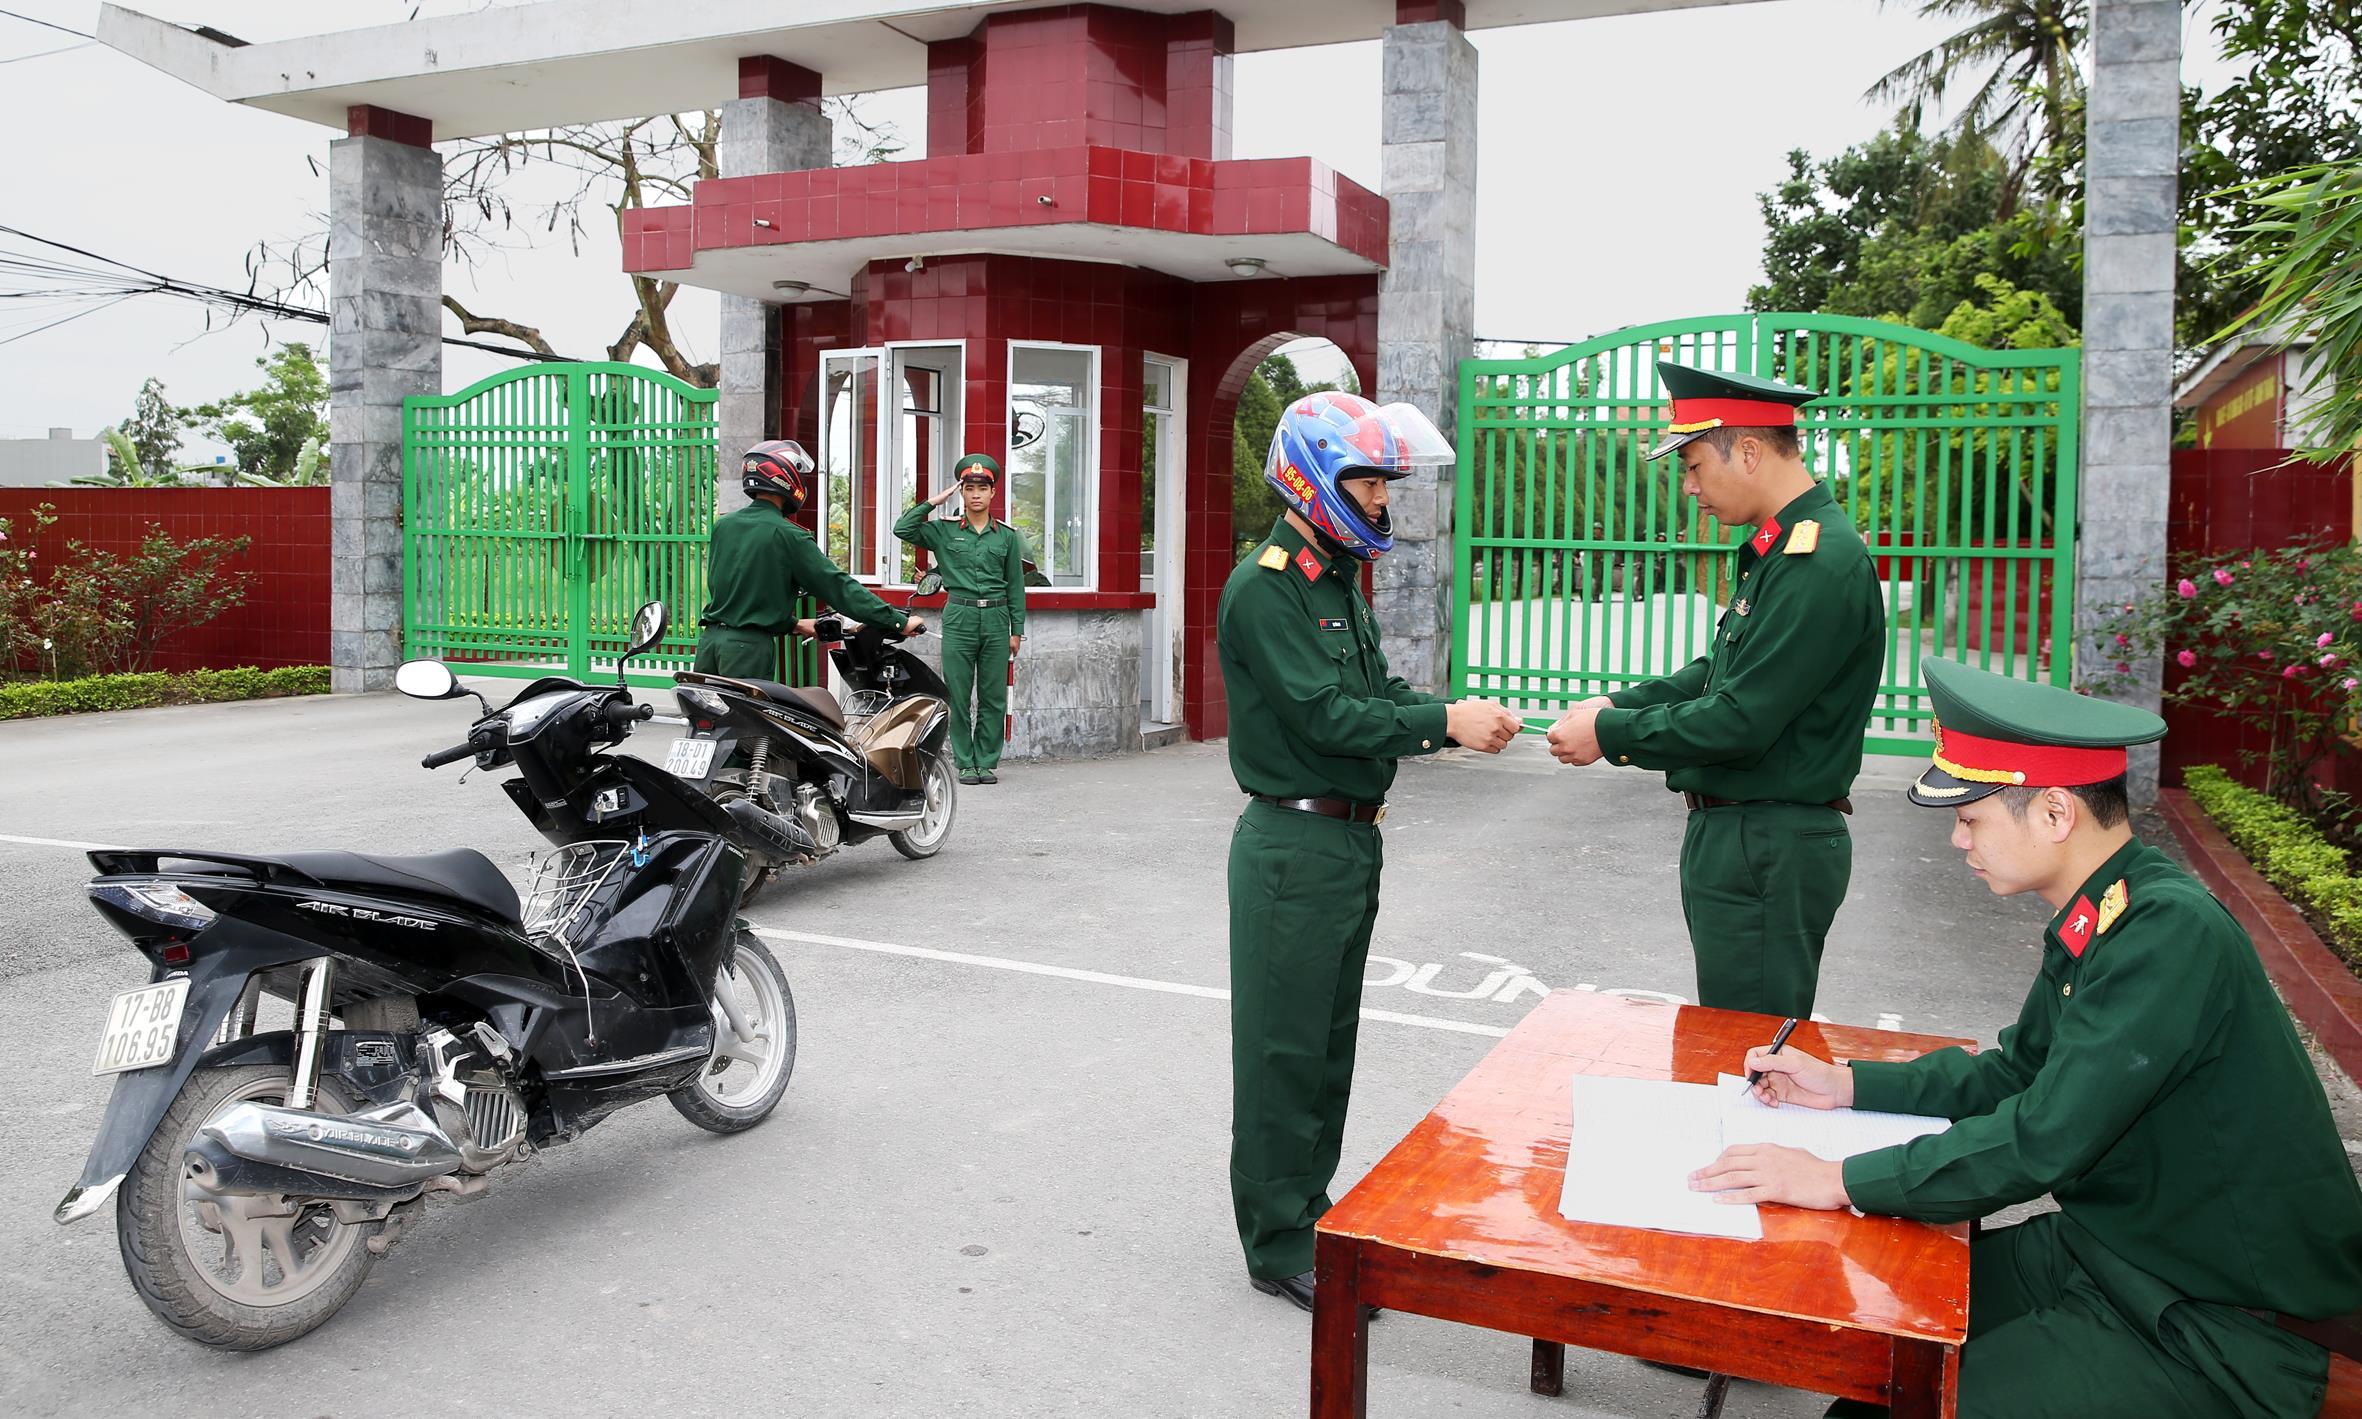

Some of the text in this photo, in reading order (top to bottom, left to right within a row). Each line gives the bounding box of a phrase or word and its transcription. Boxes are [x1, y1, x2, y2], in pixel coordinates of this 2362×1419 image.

[1284, 466, 1315, 501] 95-08-06
[666, 758, 706, 775] 200.49
[296, 901, 439, 931] AIR BLADE
[121, 987, 175, 1028] 17-B8
[103, 1023, 174, 1068] 106.95
